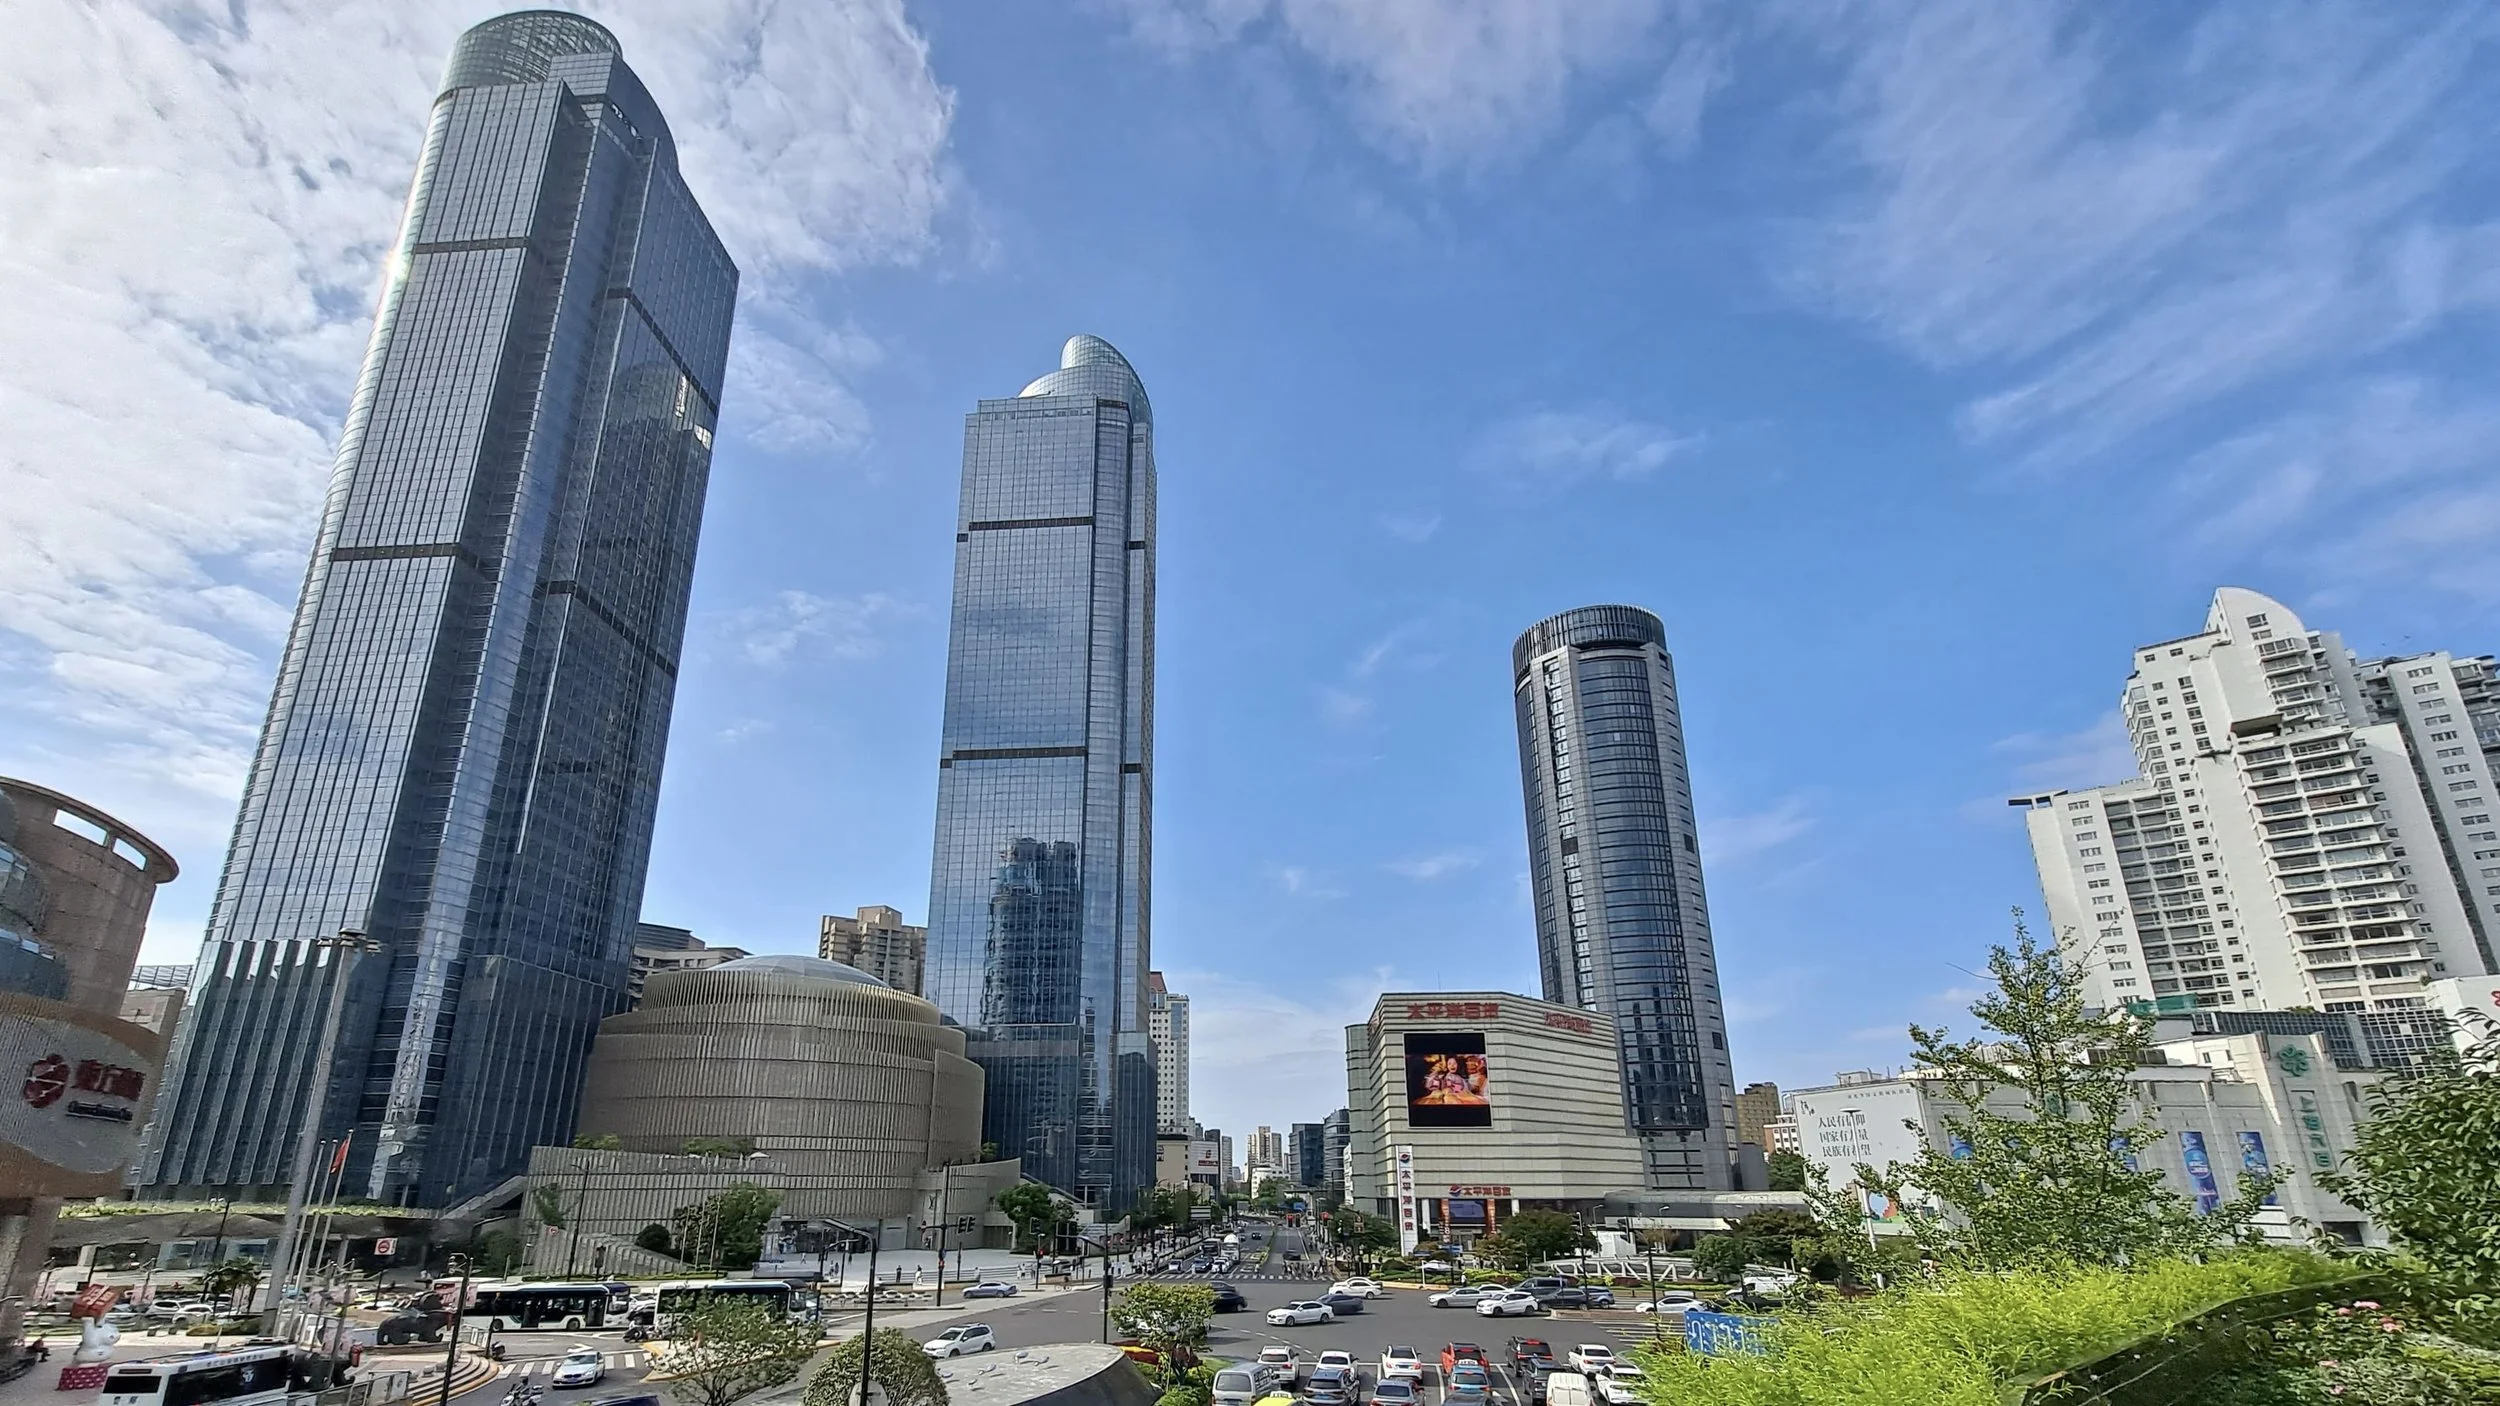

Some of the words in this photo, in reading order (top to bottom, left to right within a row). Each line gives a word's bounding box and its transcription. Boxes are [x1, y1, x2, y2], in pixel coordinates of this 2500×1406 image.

[1407, 1002, 1499, 1019] 太平洋百货
[1463, 1186, 1511, 1196] 太平洋百货
[1401, 1170, 1414, 1231] 太平洋百货
